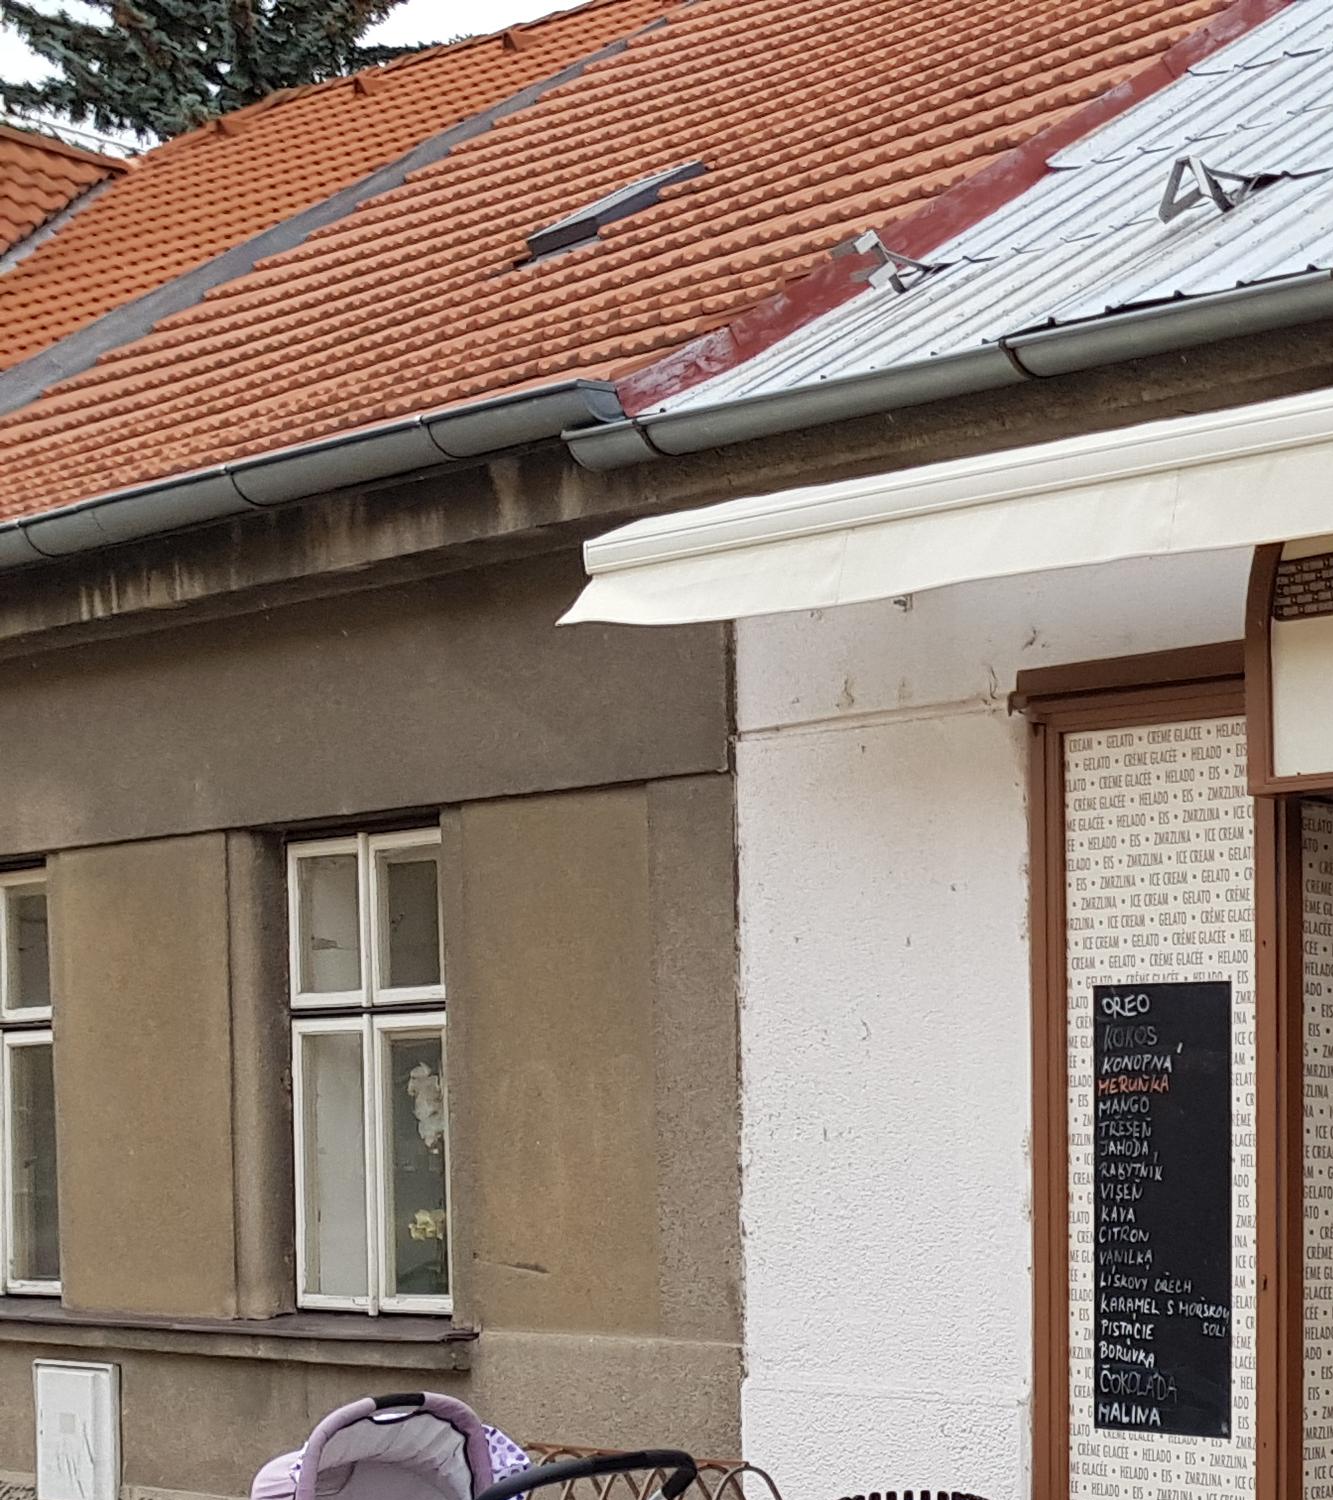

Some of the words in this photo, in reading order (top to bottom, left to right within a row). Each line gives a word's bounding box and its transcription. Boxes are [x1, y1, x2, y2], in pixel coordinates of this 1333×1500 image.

[1101, 993, 1150, 1019] OREO
[1099, 1095, 1150, 1118] MANGO
[1100, 1139, 1149, 1157] JAHODA
[1099, 1225, 1150, 1243] CITRON
[1100, 1249, 1153, 1266] VANILKA
[1100, 1293, 1161, 1316] KARAMEL
[1167, 1299, 1175, 1315] S
[1321, 1365, 1333, 1380] EIS
[1098, 1402, 1161, 1427] MALINA
[1314, 1465, 1327, 1480] ICE
